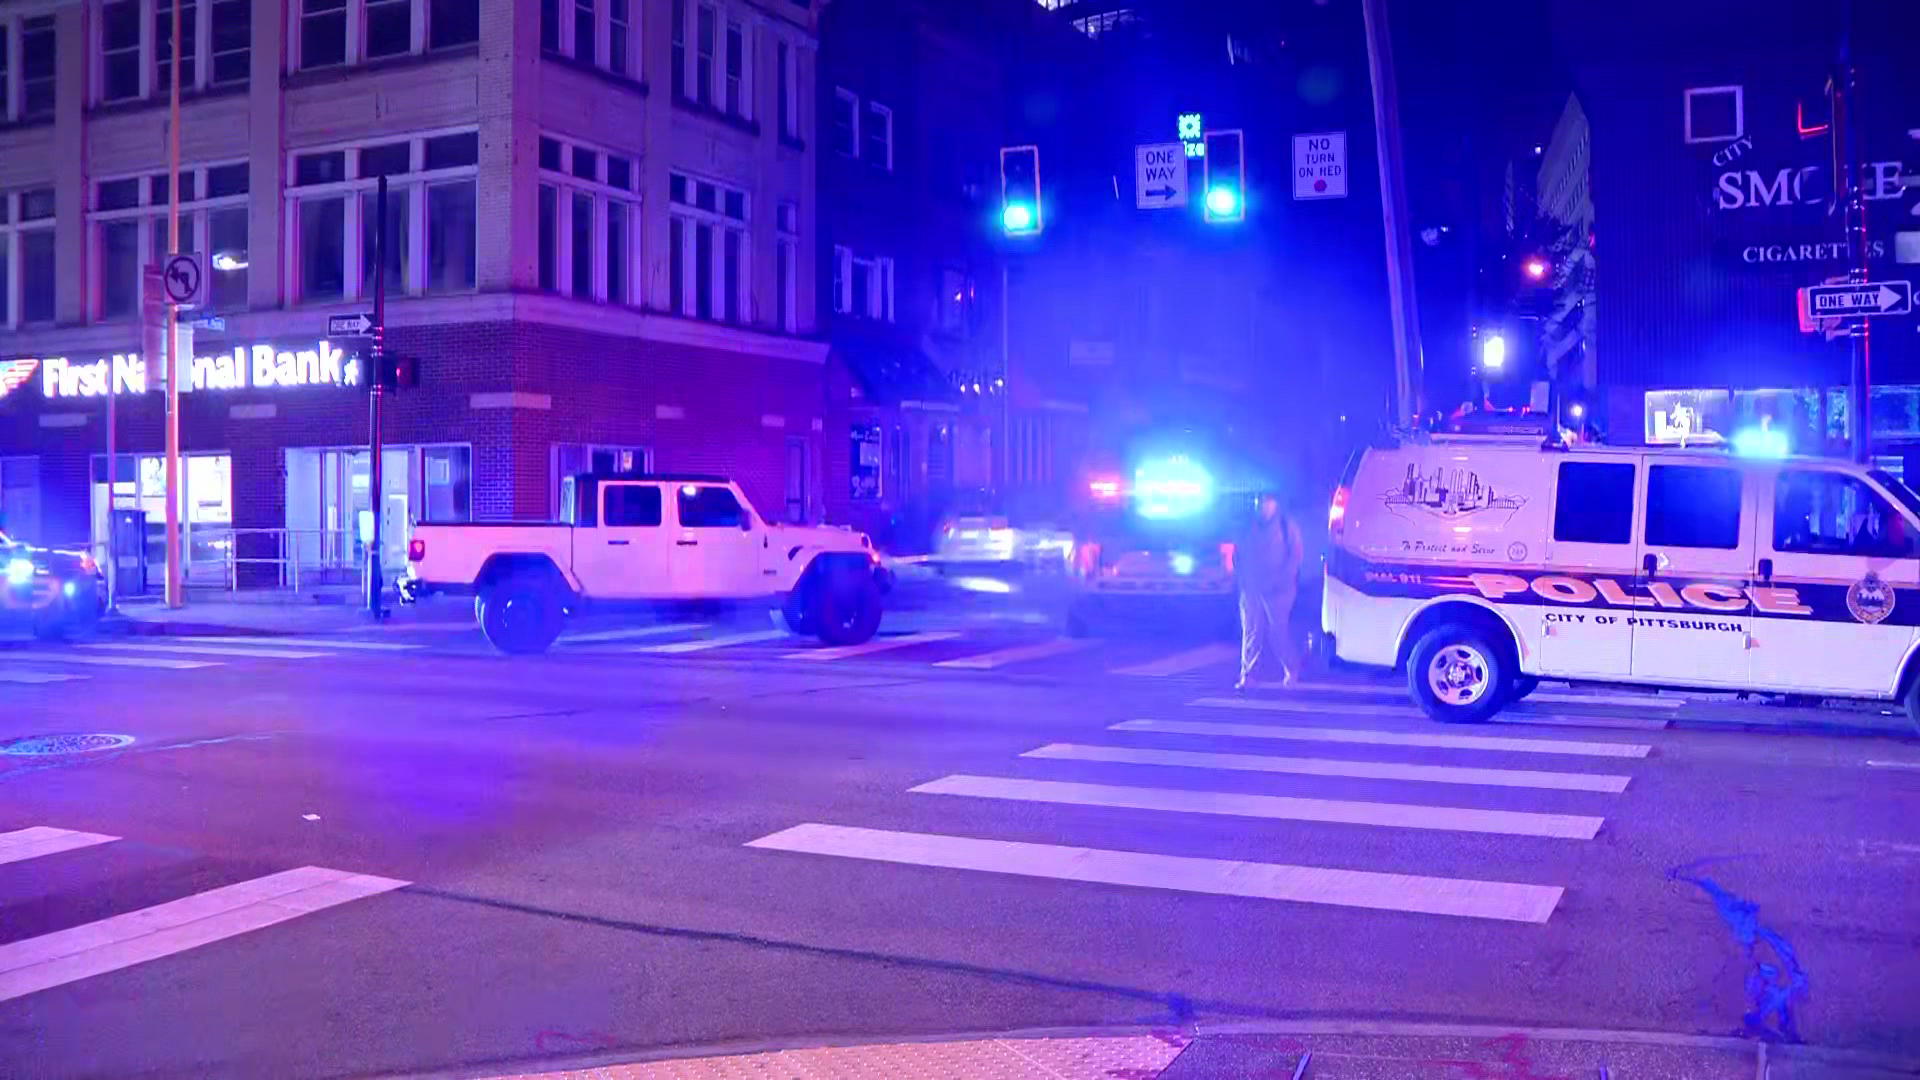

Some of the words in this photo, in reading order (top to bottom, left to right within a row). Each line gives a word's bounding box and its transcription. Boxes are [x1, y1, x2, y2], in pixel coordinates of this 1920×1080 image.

[1308, 138, 1331, 152] NO
[1712, 134, 1753, 168] CITY
[1145, 150, 1176, 166] ONE
[1305, 152, 1335, 165] TURN
[1145, 165, 1177, 182] WAY
[1298, 166, 1314, 178] ON
[1319, 165, 1342, 177] RED
[1819, 295, 1845, 308] ONE
[1850, 292, 1880, 306] WAY
[42, 357, 110, 398] First
[251, 340, 344, 388] Bank
[1414, 540, 1447, 553] Protect
[1450, 544, 1468, 553] and
[1471, 572, 1814, 616] POLICE
[1545, 612, 1586, 624] CITY
[1595, 615, 1619, 625] OF
[1626, 617, 1743, 633] PITTSBURGH
